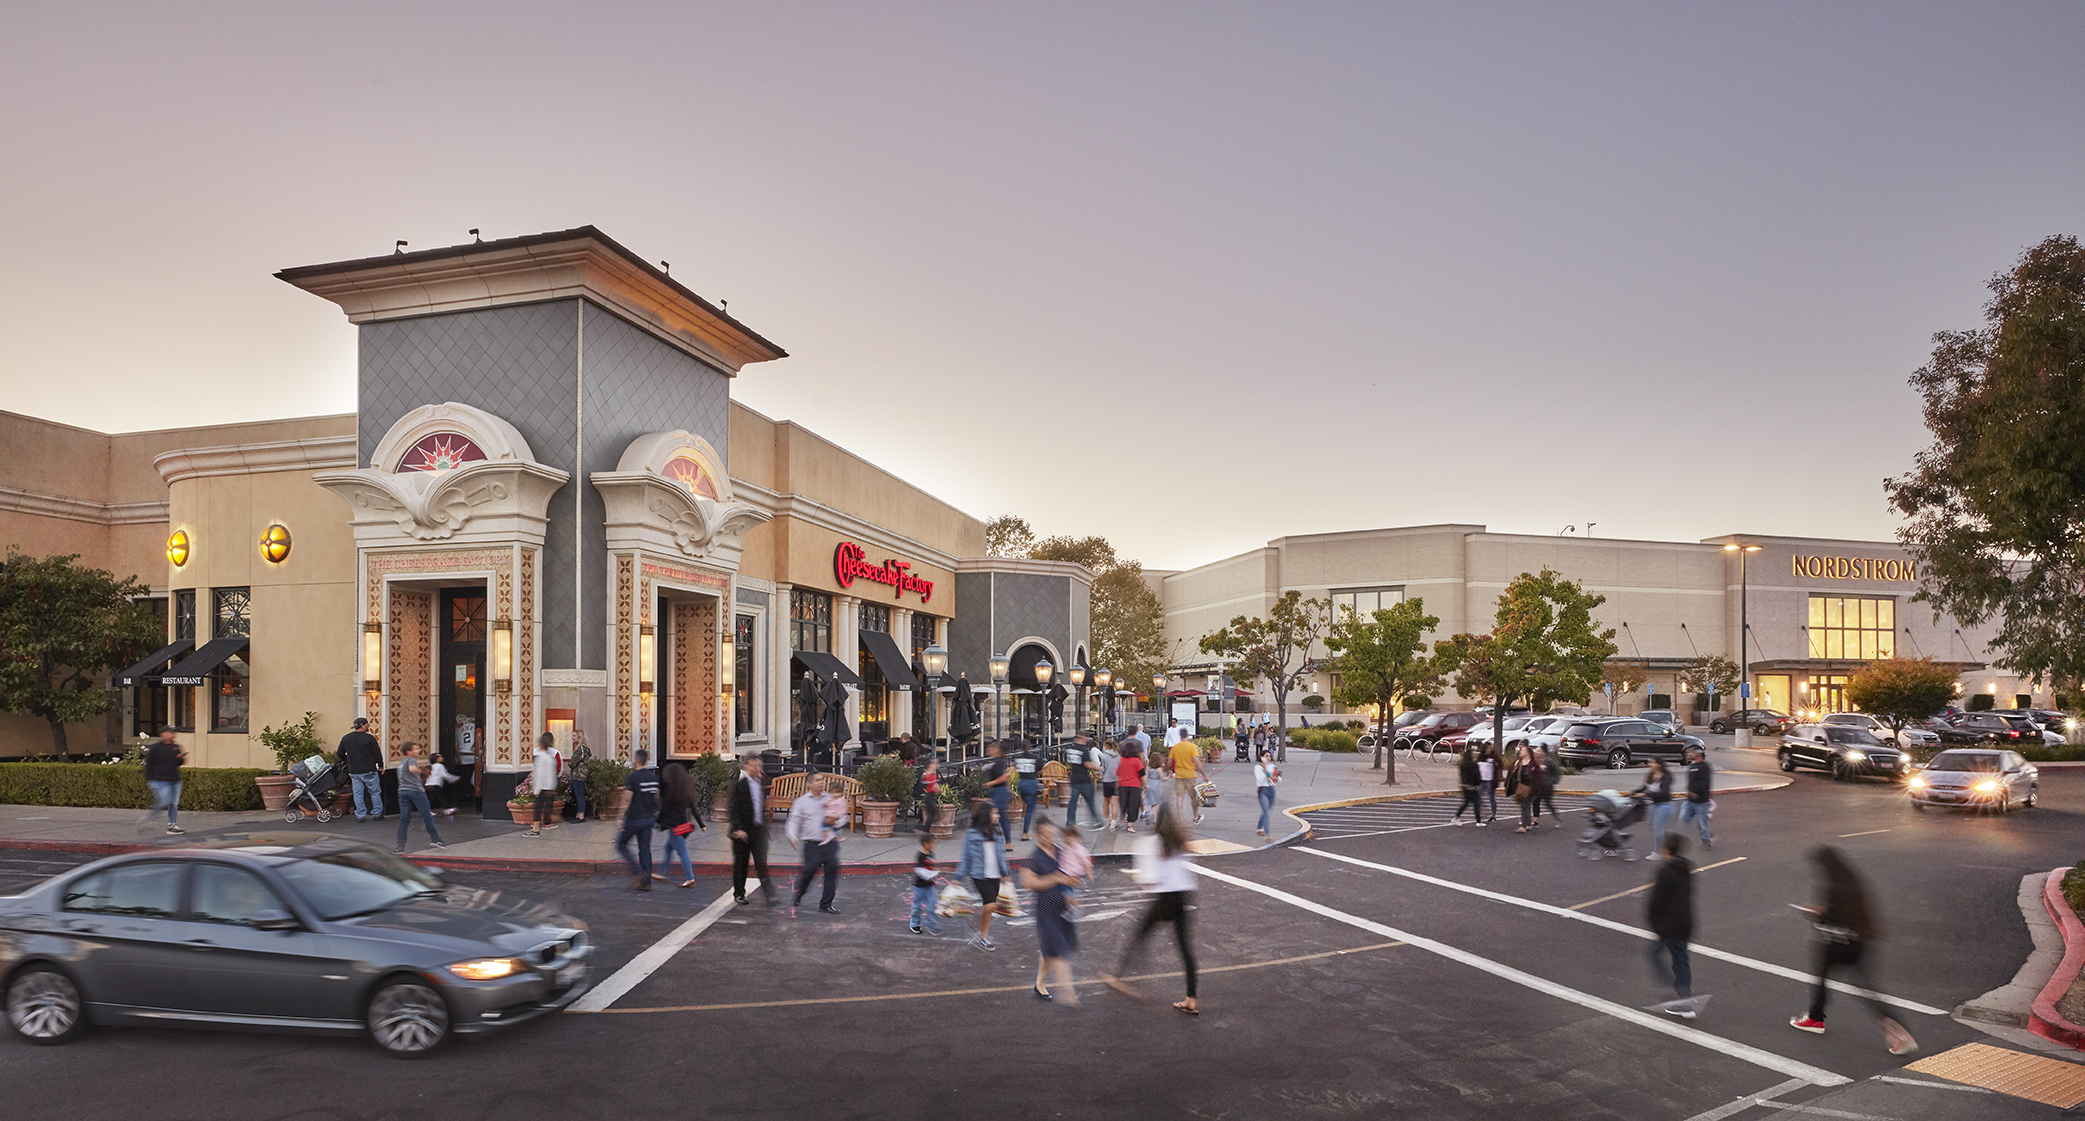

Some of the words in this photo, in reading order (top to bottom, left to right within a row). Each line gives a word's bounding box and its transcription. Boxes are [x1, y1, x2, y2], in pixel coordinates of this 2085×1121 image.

[853, 544, 866, 559] The
[371, 560, 392, 569] THE
[393, 557, 460, 568] CHEESECAKE
[462, 555, 510, 566] FACTORY
[641, 562, 658, 574] THE
[1792, 555, 1916, 581] NORDSTROM
[836, 541, 899, 588] Cheesecake
[893, 559, 934, 603] Factory
[162, 677, 201, 685] RESTAURANT
